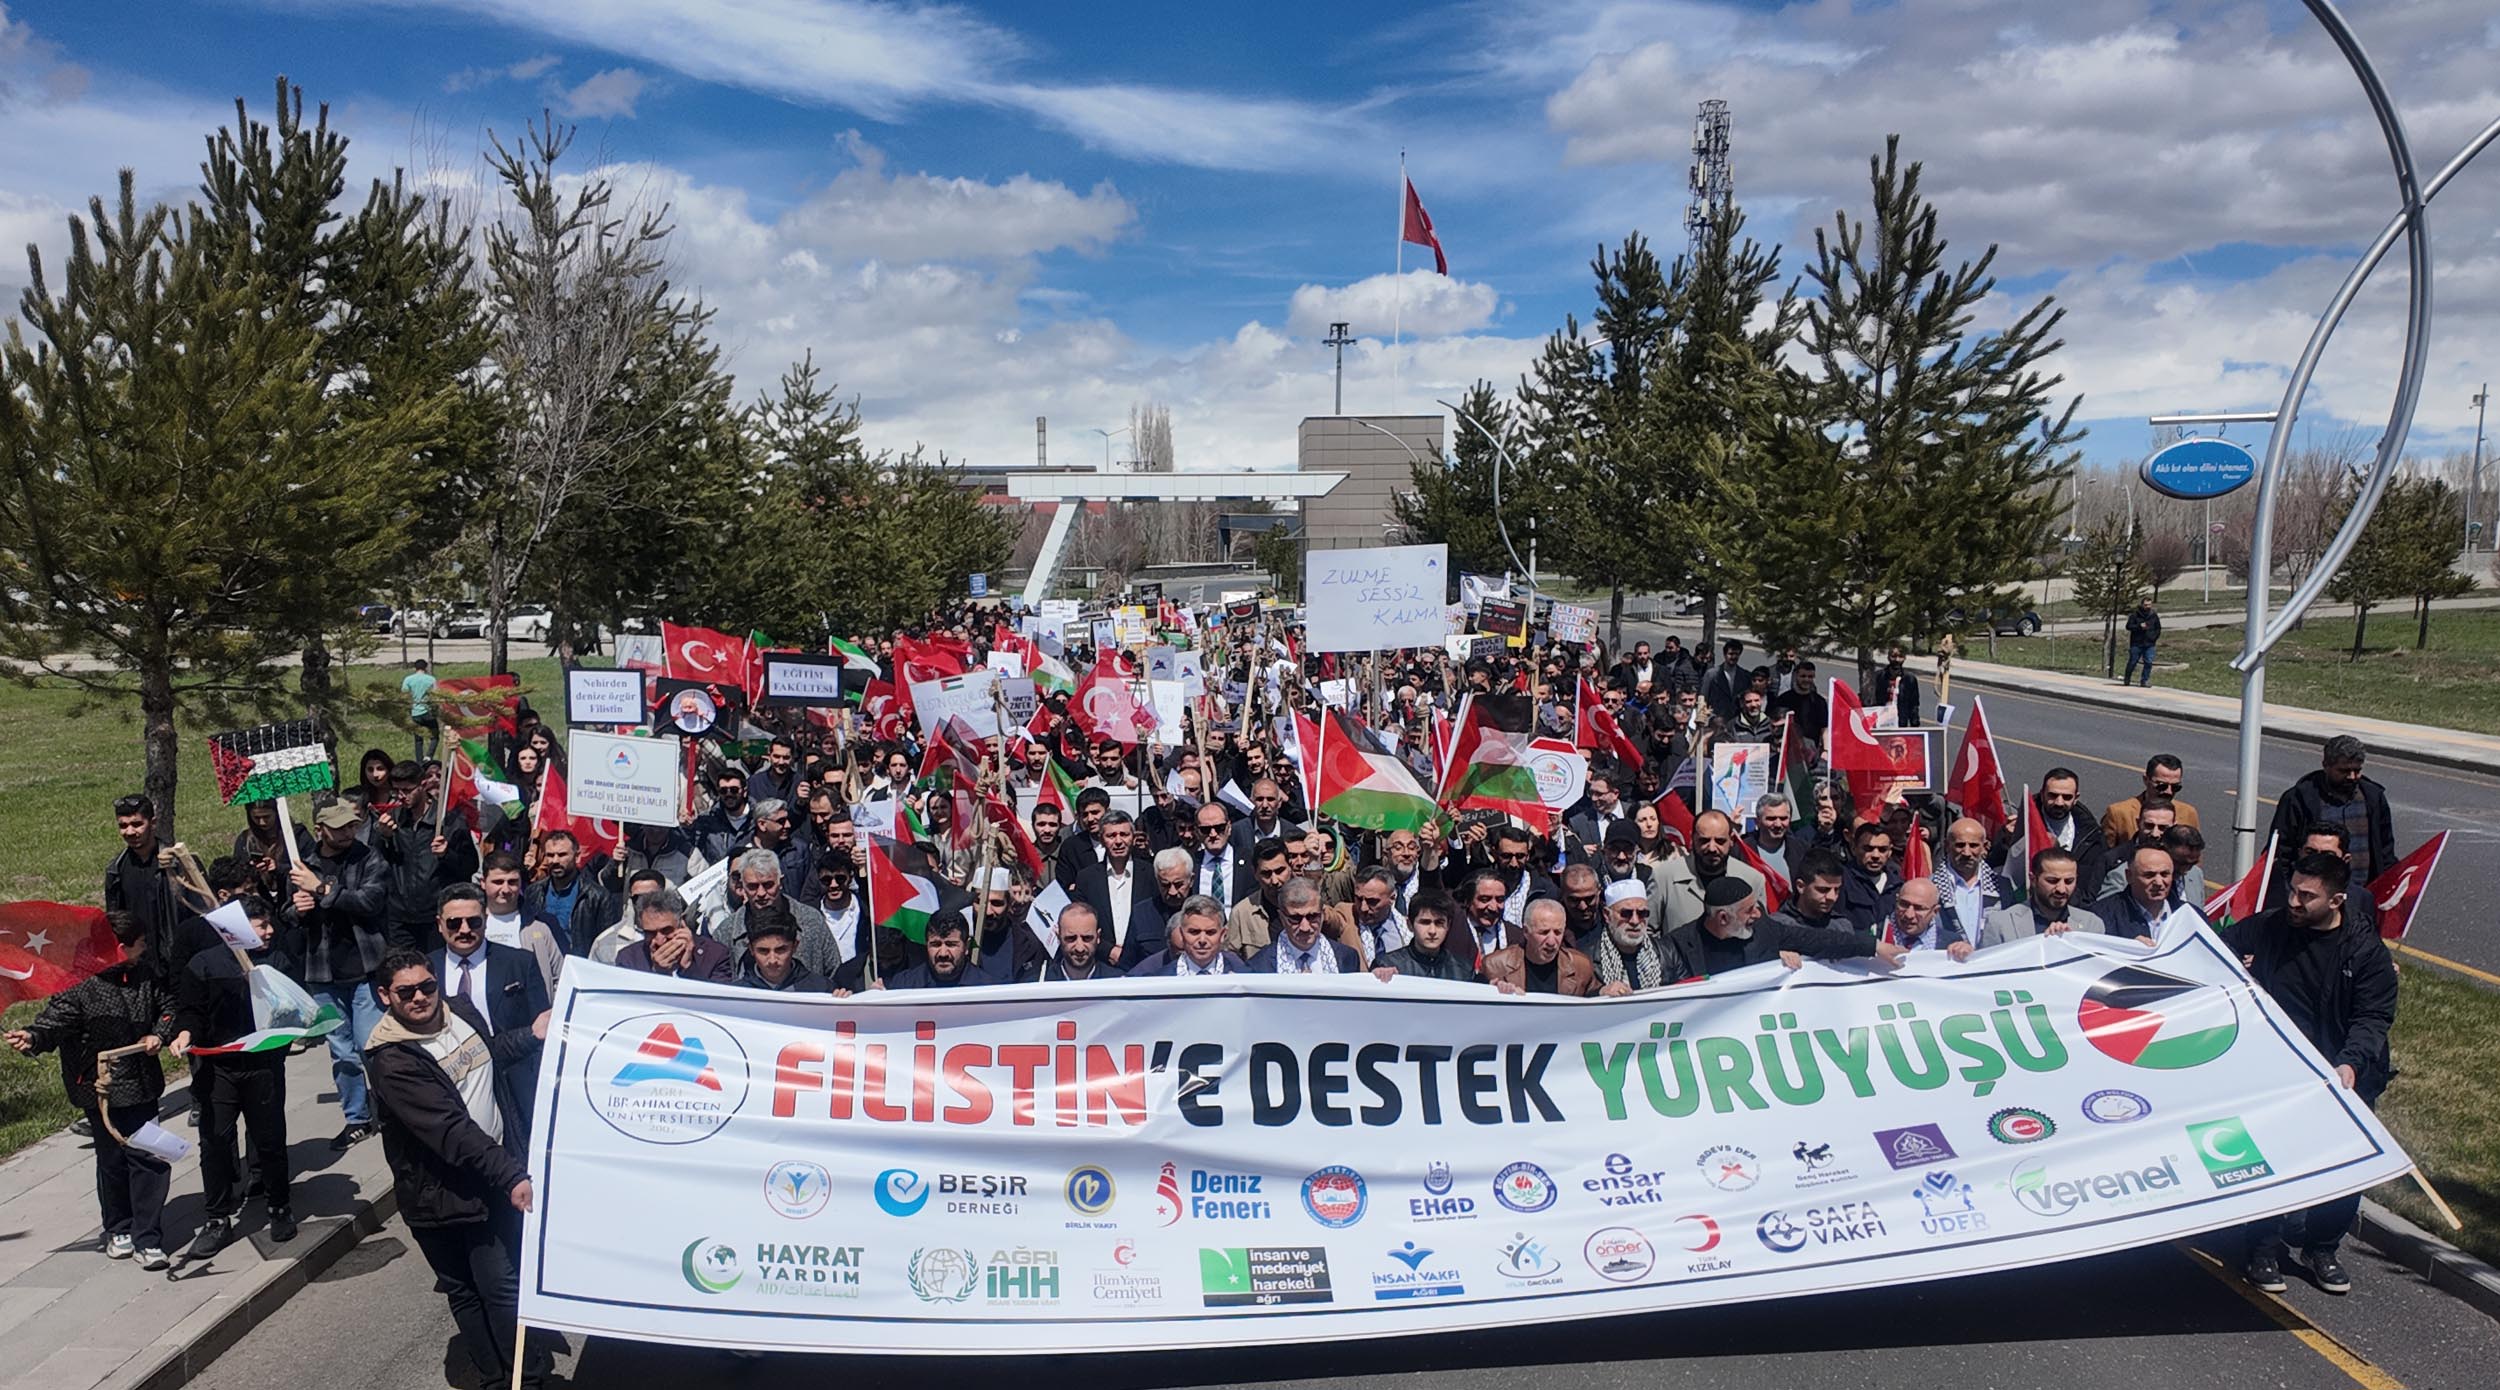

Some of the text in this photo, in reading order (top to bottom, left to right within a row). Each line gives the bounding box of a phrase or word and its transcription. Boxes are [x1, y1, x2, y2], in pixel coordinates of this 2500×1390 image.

[1322, 567, 1393, 585] ZULME
[1372, 606, 1438, 627] KALMA
[583, 677, 628, 688] Nehirden
[782, 667, 824, 680] EĞİTİM
[773, 681, 834, 694] FAKÜLTESİ
[576, 691, 636, 703] denize özgür
[589, 703, 623, 714] Filistin
[606, 792, 614, 801] VE
[602, 804, 639, 816] FAKÜLTESİ
[772, 989, 2069, 1128] FİLİSTİN'E DESTEK YÜRÜYÜŞÜ
[1191, 1169, 1262, 1194] Deniz
[1583, 1170, 1665, 1193] ensar
[2029, 1155, 2181, 1210] verenel
[2214, 1163, 2269, 1184] YEŞİLAY
[1191, 1196, 1271, 1220] Feneri
[1409, 1197, 1475, 1217] EHAD
[1600, 1191, 1663, 1207] vakfı
[1806, 1201, 1880, 1227] SAFA
[1921, 1211, 1988, 1235] UDER
[1813, 1220, 1888, 1245] VAKFI
[757, 1243, 865, 1268] HAYRAT
[990, 1245, 1058, 1265] AĞRI
[1292, 1251, 1310, 1261] ve
[758, 1266, 860, 1285] YARDIM
[1251, 1262, 1326, 1278] medeniyet
[1687, 1259, 1732, 1274] KIZILAY
[1120, 1274, 1160, 1289] Yayma
[1253, 1276, 1316, 1292] hareketi
[1372, 1269, 1461, 1286] İNSAN VAKFI
[1093, 1285, 1162, 1304] Cemiyeti
